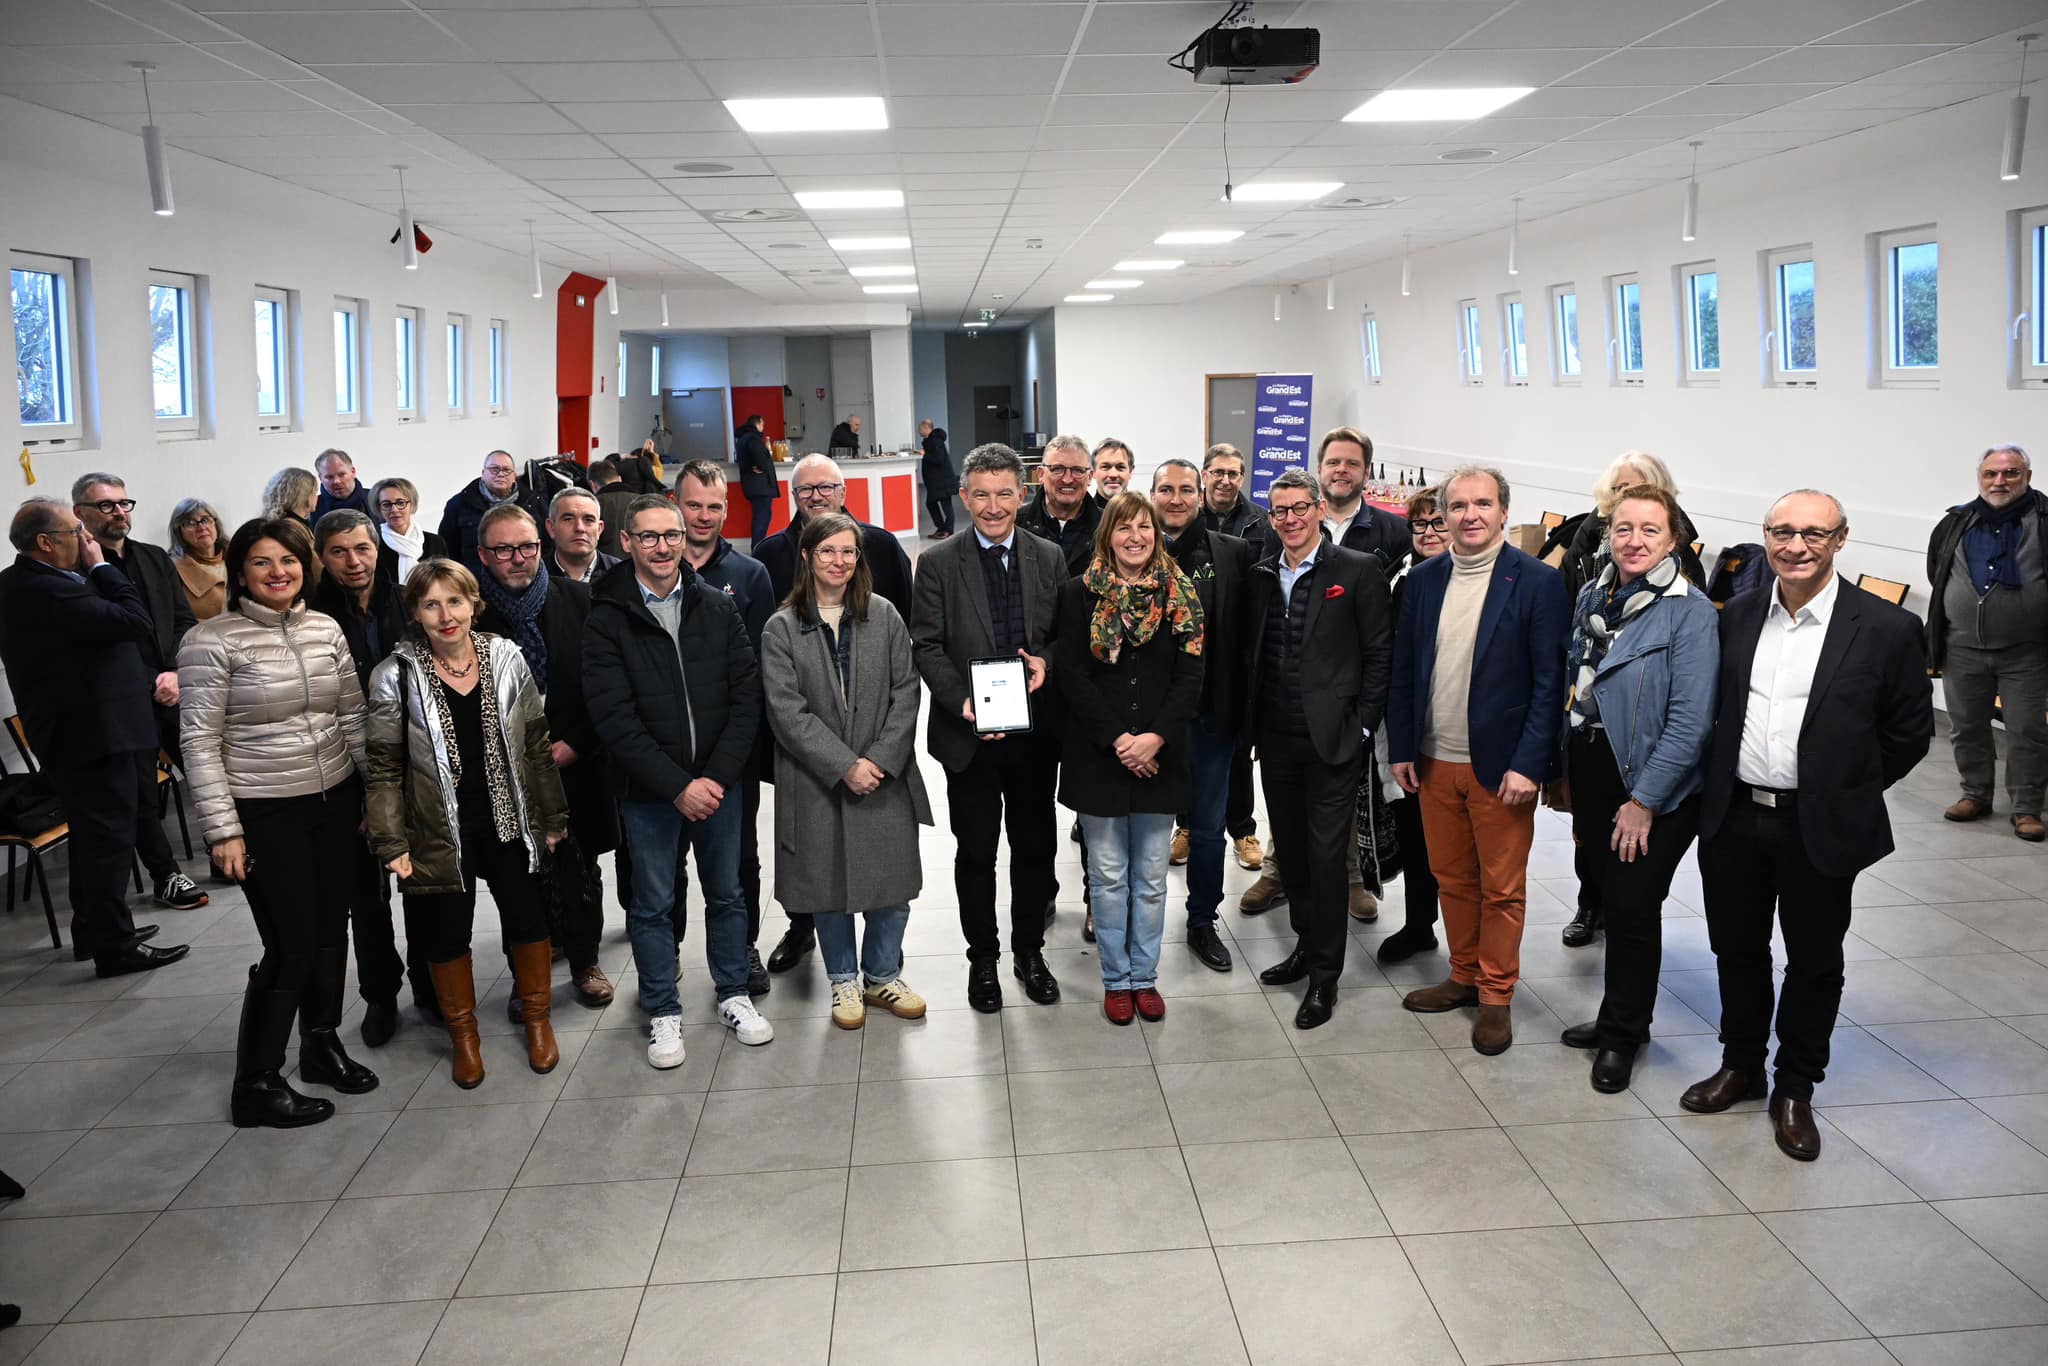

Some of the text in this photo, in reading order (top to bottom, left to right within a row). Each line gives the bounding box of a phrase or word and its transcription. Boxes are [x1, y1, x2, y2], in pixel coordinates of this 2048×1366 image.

[1266, 385, 1289, 394] Grand
[1289, 385, 1302, 394] Est
[1259, 449, 1302, 460] Grand Est
